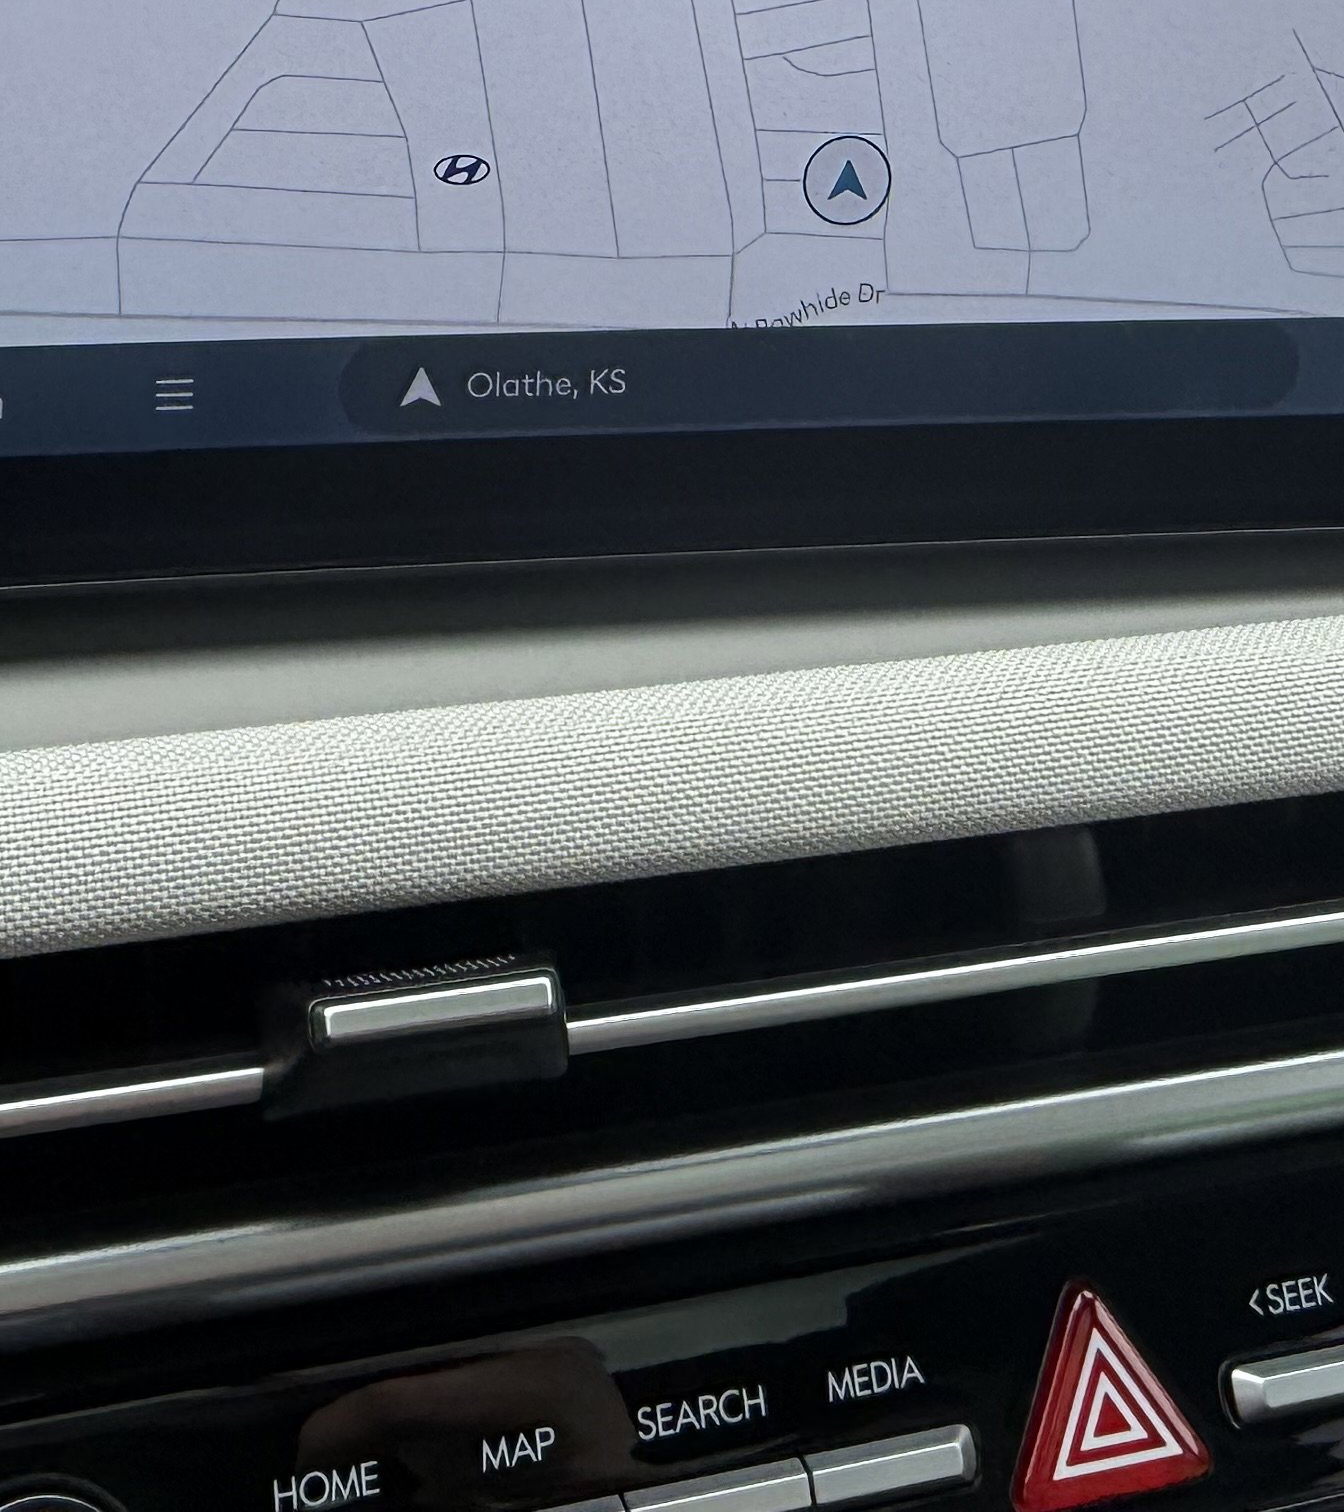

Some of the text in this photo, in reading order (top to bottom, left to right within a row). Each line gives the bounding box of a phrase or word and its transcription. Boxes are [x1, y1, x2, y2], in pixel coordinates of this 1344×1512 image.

[858, 282, 886, 304] Dr
[467, 367, 627, 400] Olathe, KS
[826, 1356, 925, 1403] MEDIA
[635, 1385, 768, 1442] SEARCH
[480, 1426, 557, 1473] MAP
[273, 1460, 381, 1512] HOME
